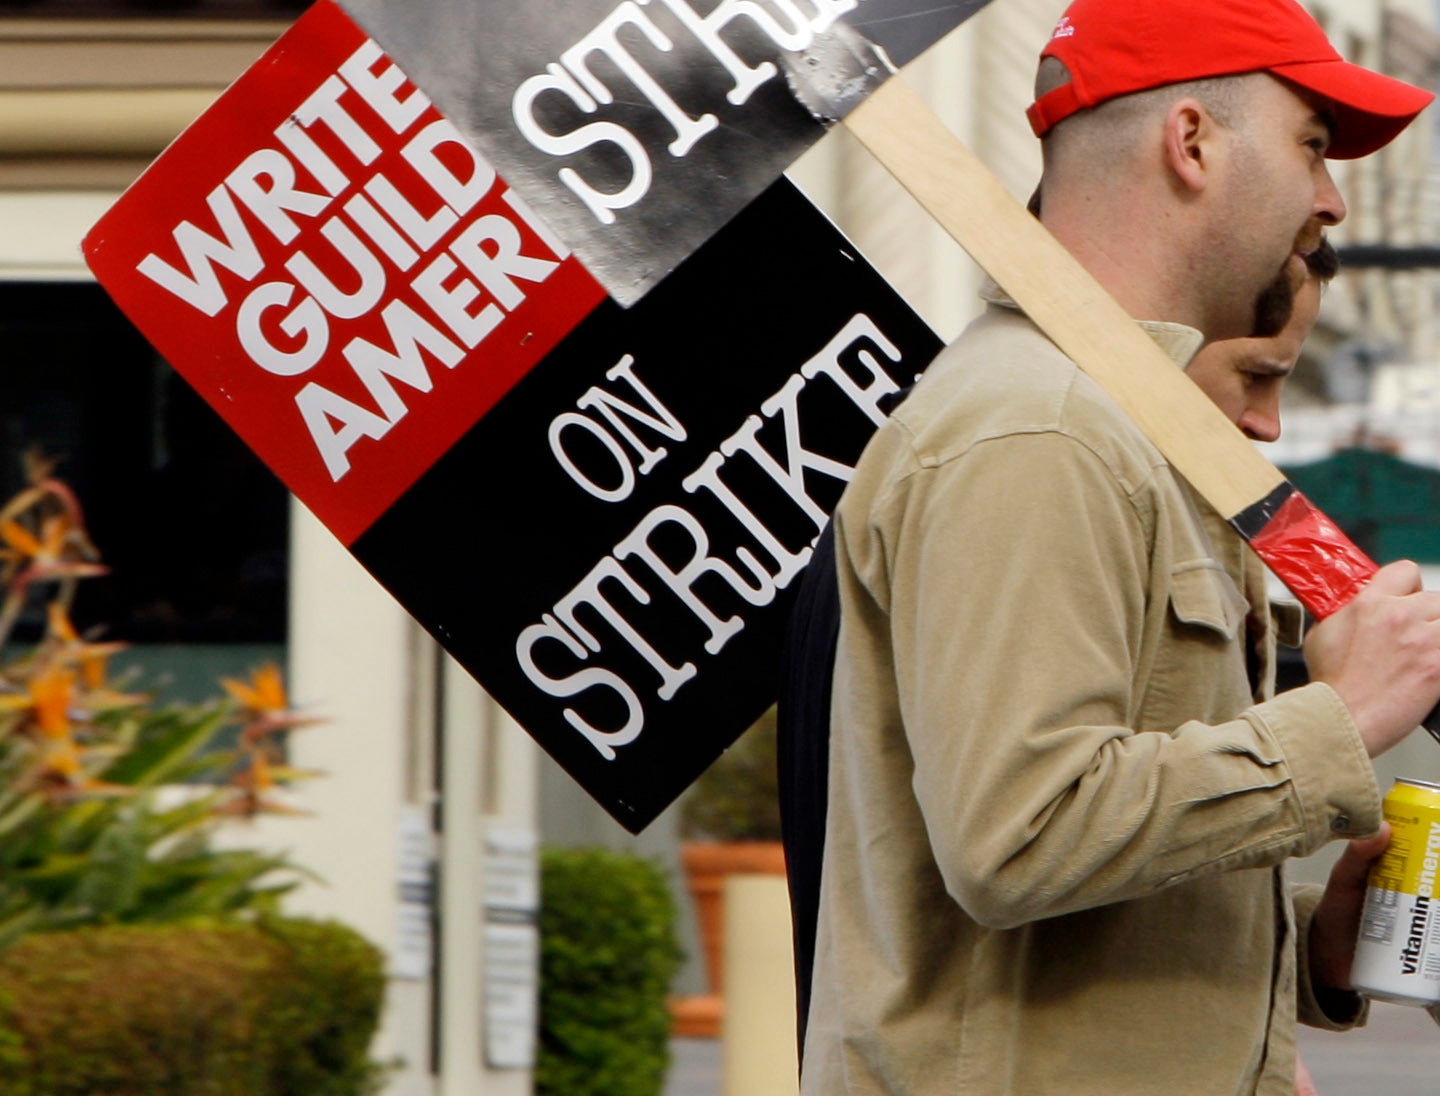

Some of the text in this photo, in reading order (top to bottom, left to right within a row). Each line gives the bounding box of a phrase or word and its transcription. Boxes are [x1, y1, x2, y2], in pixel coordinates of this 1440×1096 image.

[137, 38, 432, 317] WRITE
[236, 118, 496, 377] GUILD
[547, 354, 688, 503] ON
